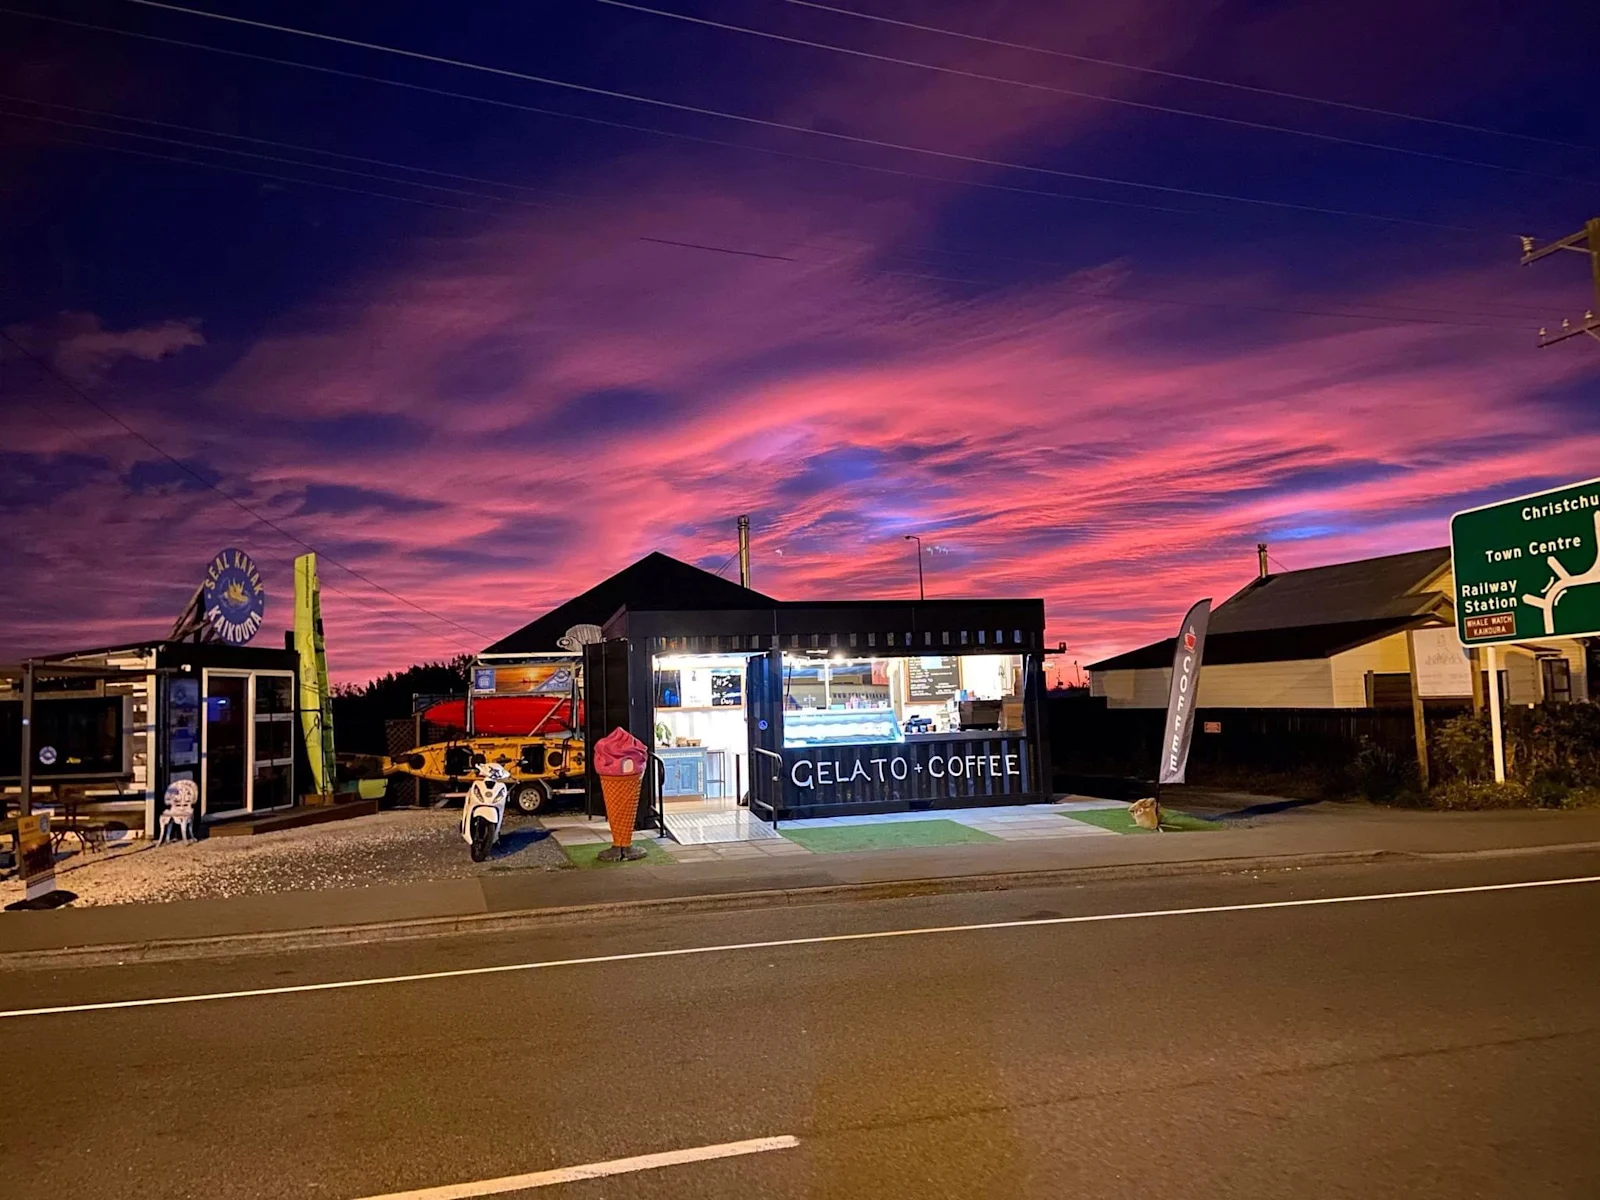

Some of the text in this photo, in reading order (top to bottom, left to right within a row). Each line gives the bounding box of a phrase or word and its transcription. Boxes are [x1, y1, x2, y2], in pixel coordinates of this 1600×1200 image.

[1522, 494, 1600, 521] Christchu
[1485, 536, 1582, 564] Town Centre
[205, 552, 230, 590] SEAL
[233, 551, 263, 596] KAYAK
[1461, 579, 1518, 598] Railway
[1464, 596, 1518, 614] Station
[208, 604, 262, 643] KAIKOURA
[1466, 615, 1513, 628] WHALE WATCH
[1473, 625, 1507, 636] KAIKOURA
[1169, 655, 1192, 772] COFFEE
[791, 756, 907, 789] GELATO
[928, 754, 1020, 779] COFFEE
